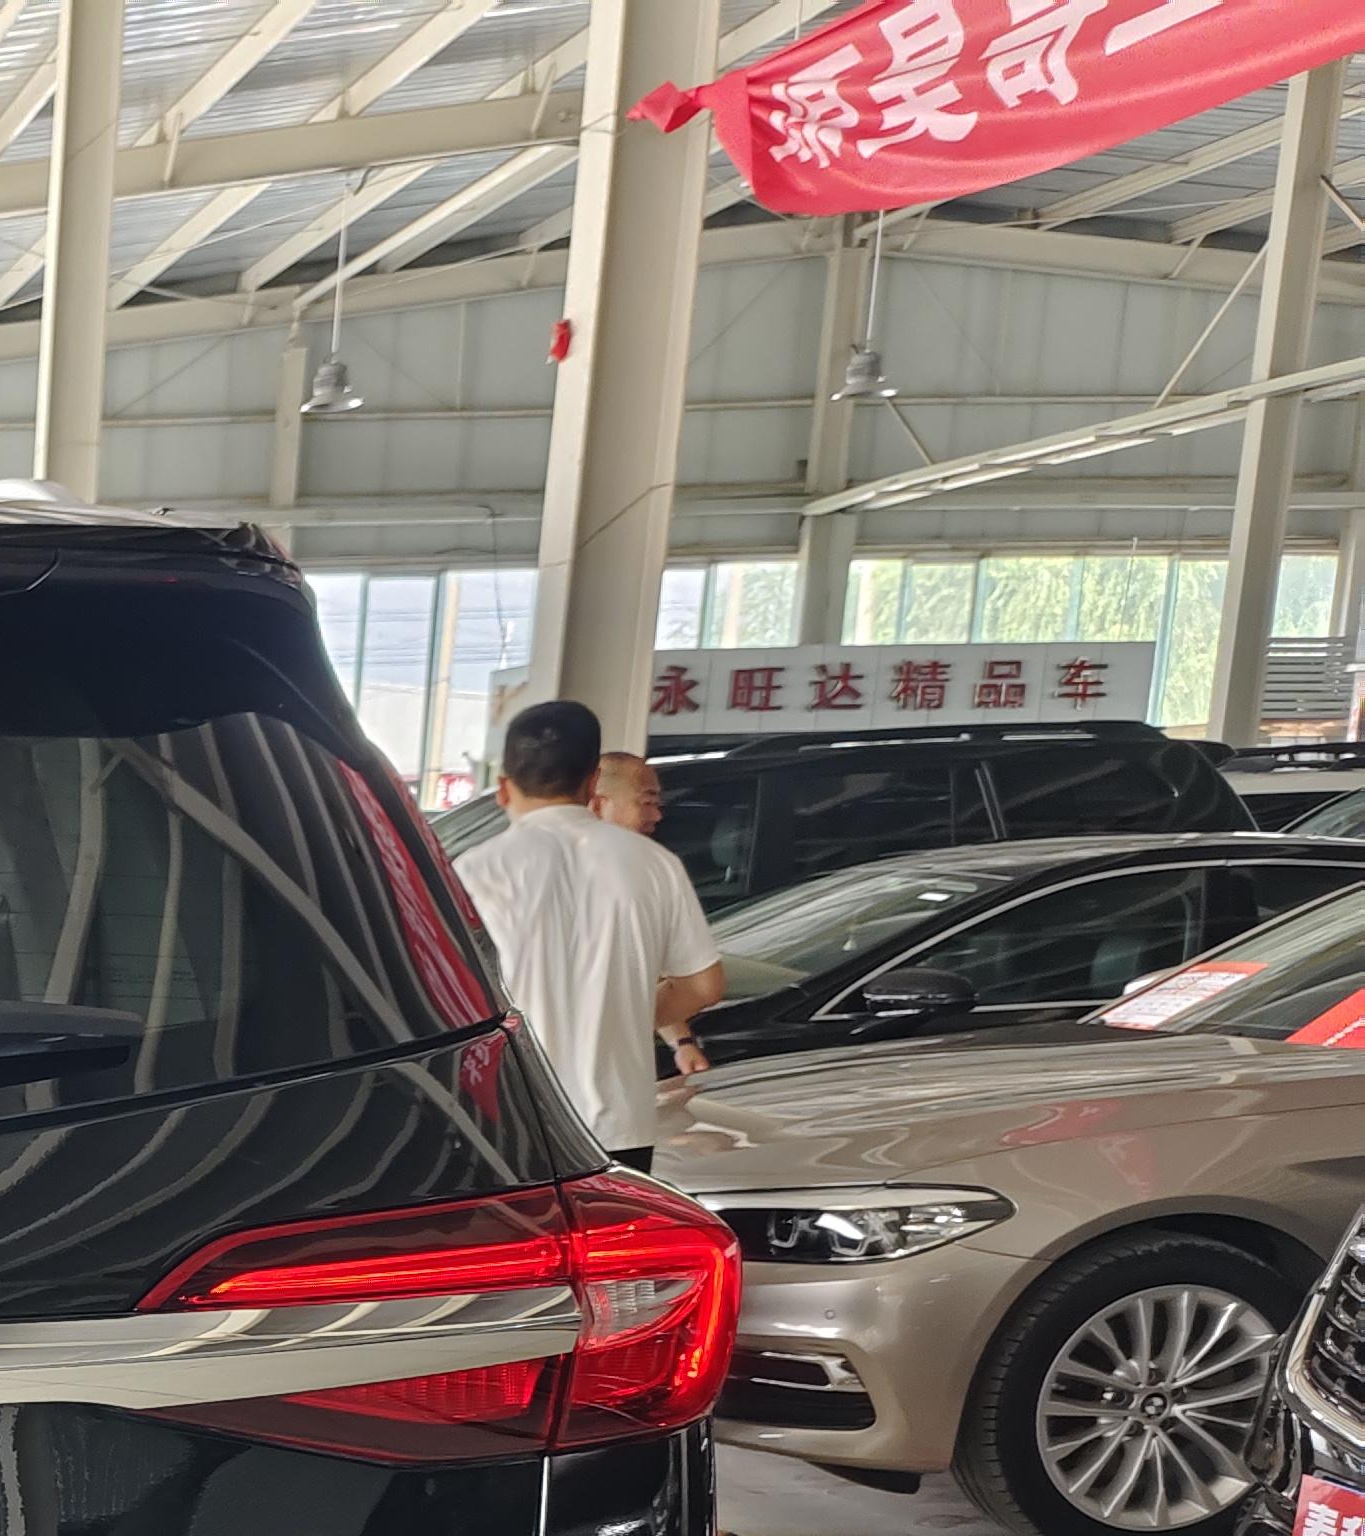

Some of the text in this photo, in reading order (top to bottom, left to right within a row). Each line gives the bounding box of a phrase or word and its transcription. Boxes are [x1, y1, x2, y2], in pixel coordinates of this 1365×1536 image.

[649, 656, 1109, 716] 永旺达精品车
